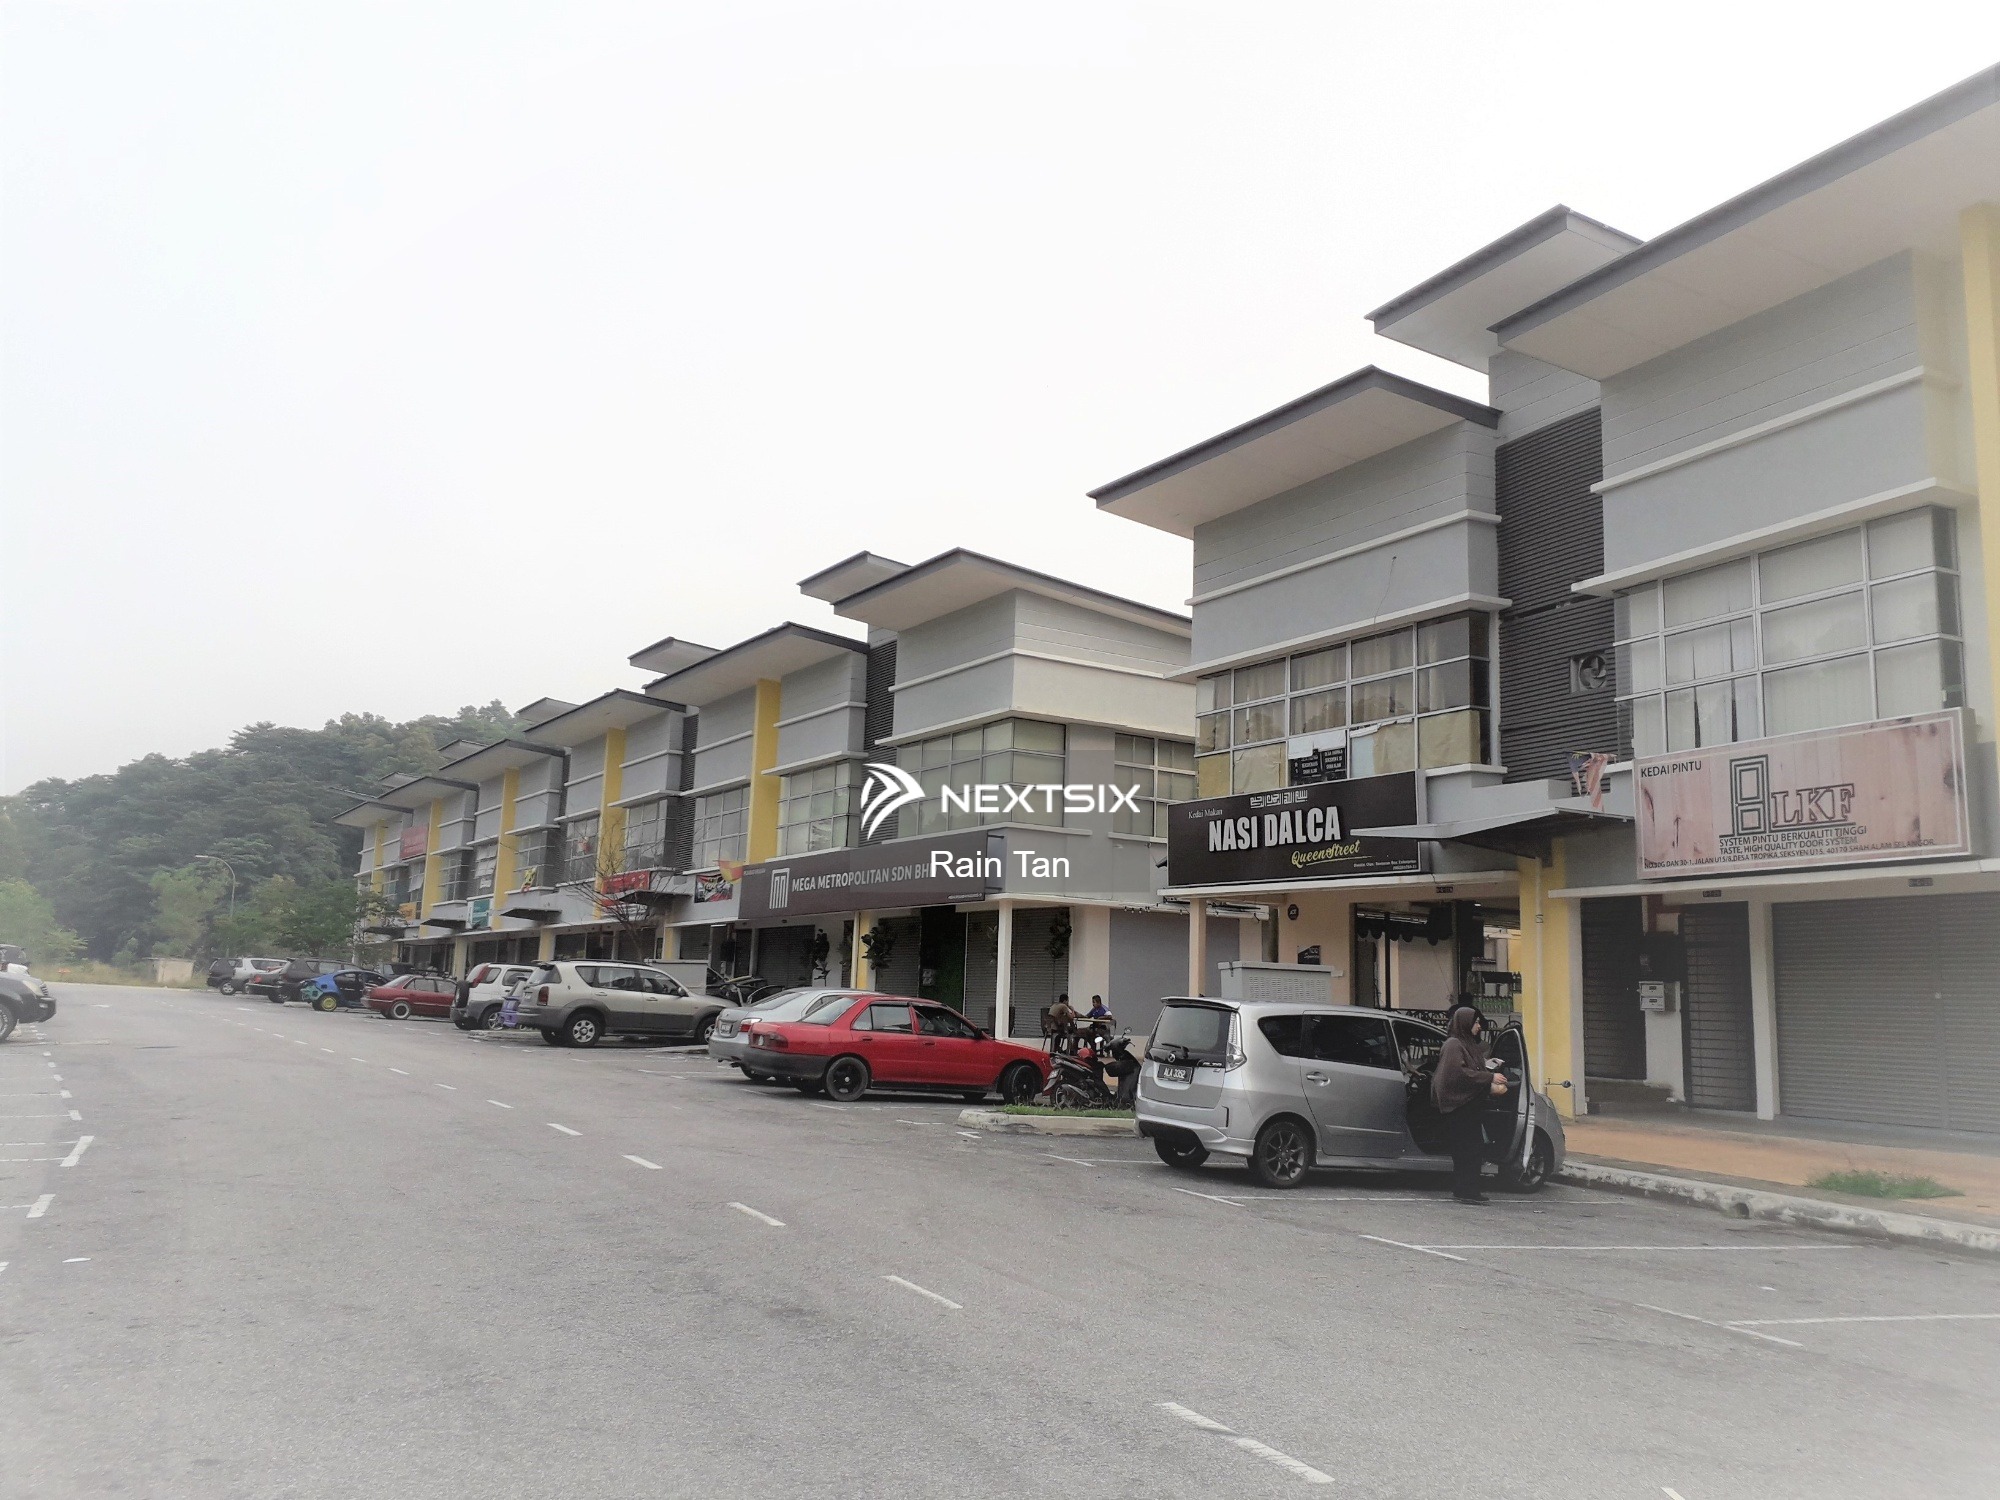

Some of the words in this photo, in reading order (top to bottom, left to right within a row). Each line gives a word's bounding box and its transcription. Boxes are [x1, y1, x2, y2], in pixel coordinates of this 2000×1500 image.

[1641, 765, 1670, 778] KEDAI
[1672, 760, 1702, 774] PINTU
[1770, 783, 1856, 829] LKF
[1208, 815, 1258, 852] NASI
[1264, 806, 1341, 847] DALCA
[1719, 835, 1751, 848] SYSTEM
[1752, 832, 1779, 845] PINTU
[1835, 825, 1867, 837] TINGGI
[1694, 857, 1714, 865] JALAN
[1849, 843, 1869, 853] SHAH
[1871, 841, 1893, 850] ALAM
[1744, 843, 1763, 853] HIGH
[1764, 841, 1798, 852] QUALITY
[1799, 838, 1824, 849] DOOR
[1825, 836, 1858, 846] SYSTEM
[792, 876, 816, 892] MEGA
[817, 867, 890, 889] METROPOLITAN
[891, 864, 913, 882] SDN
